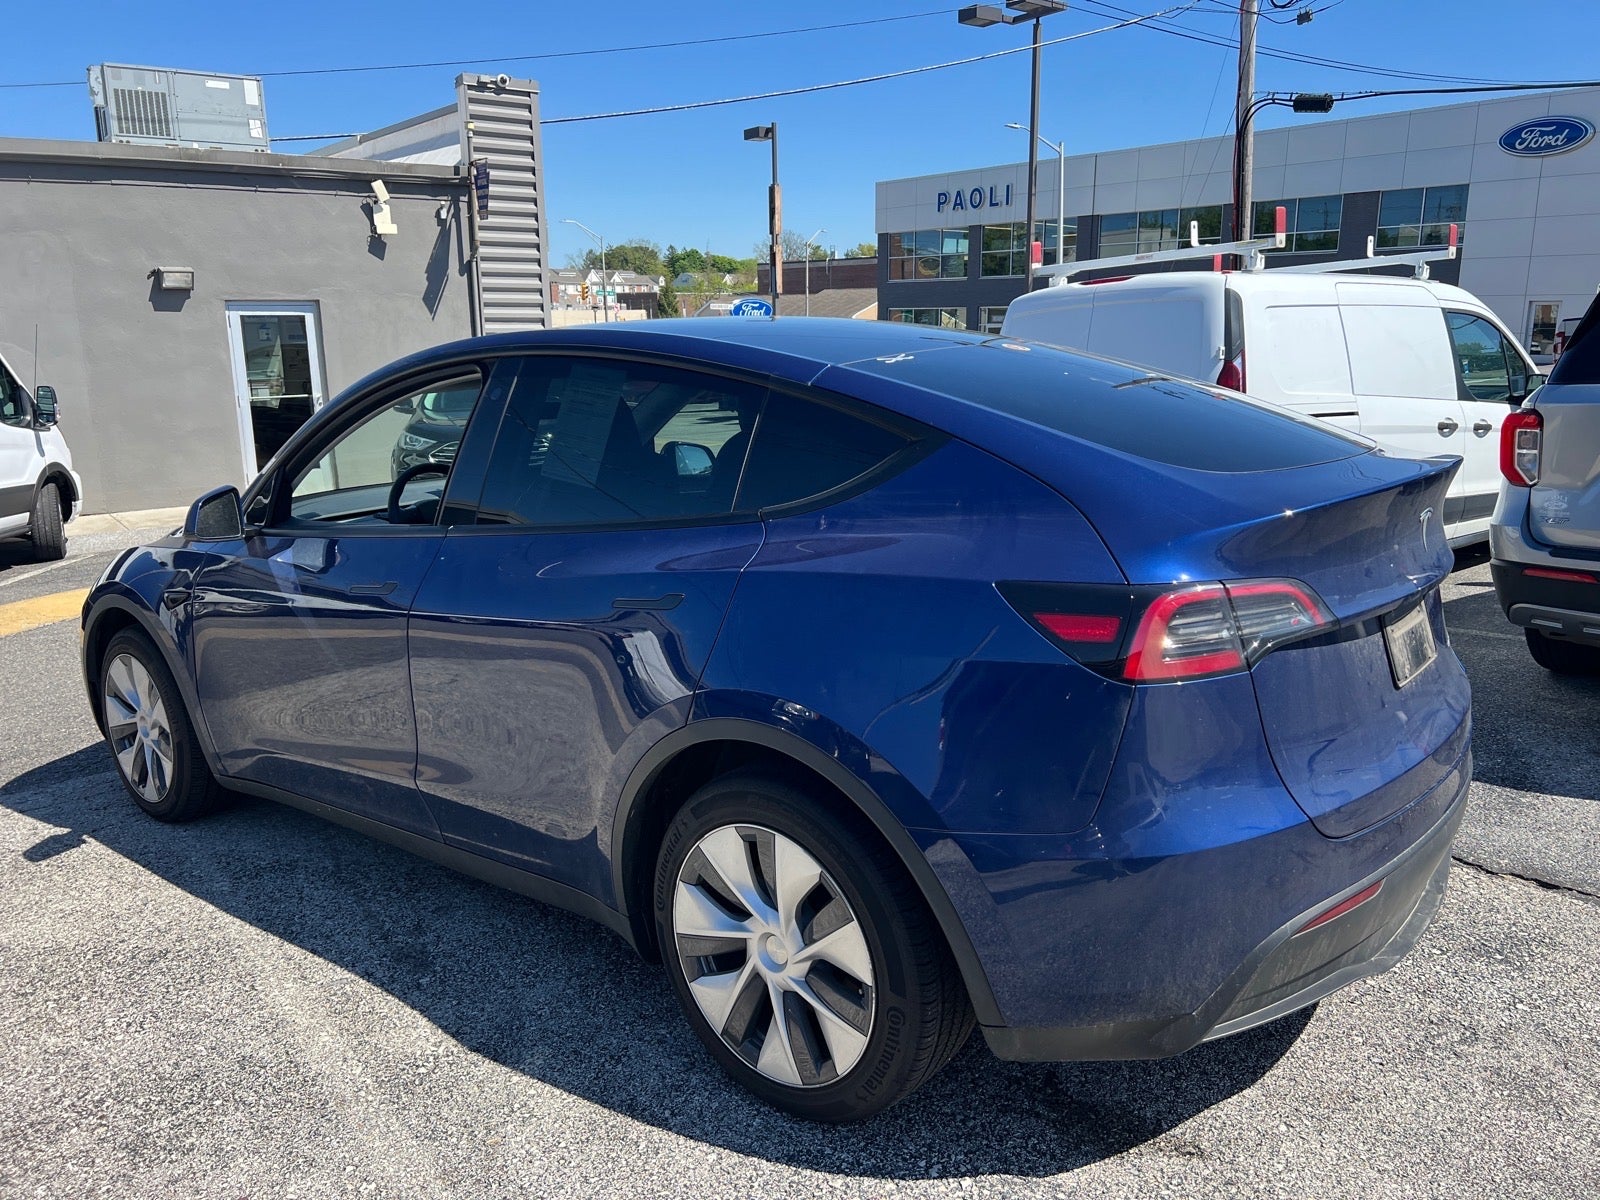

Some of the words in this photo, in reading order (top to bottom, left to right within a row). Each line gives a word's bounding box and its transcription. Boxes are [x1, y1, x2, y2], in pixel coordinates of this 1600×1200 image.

[1515, 125, 1570, 150] Ford
[937, 184, 1011, 212] PAOLI
[861, 1006, 905, 1096] Continental
